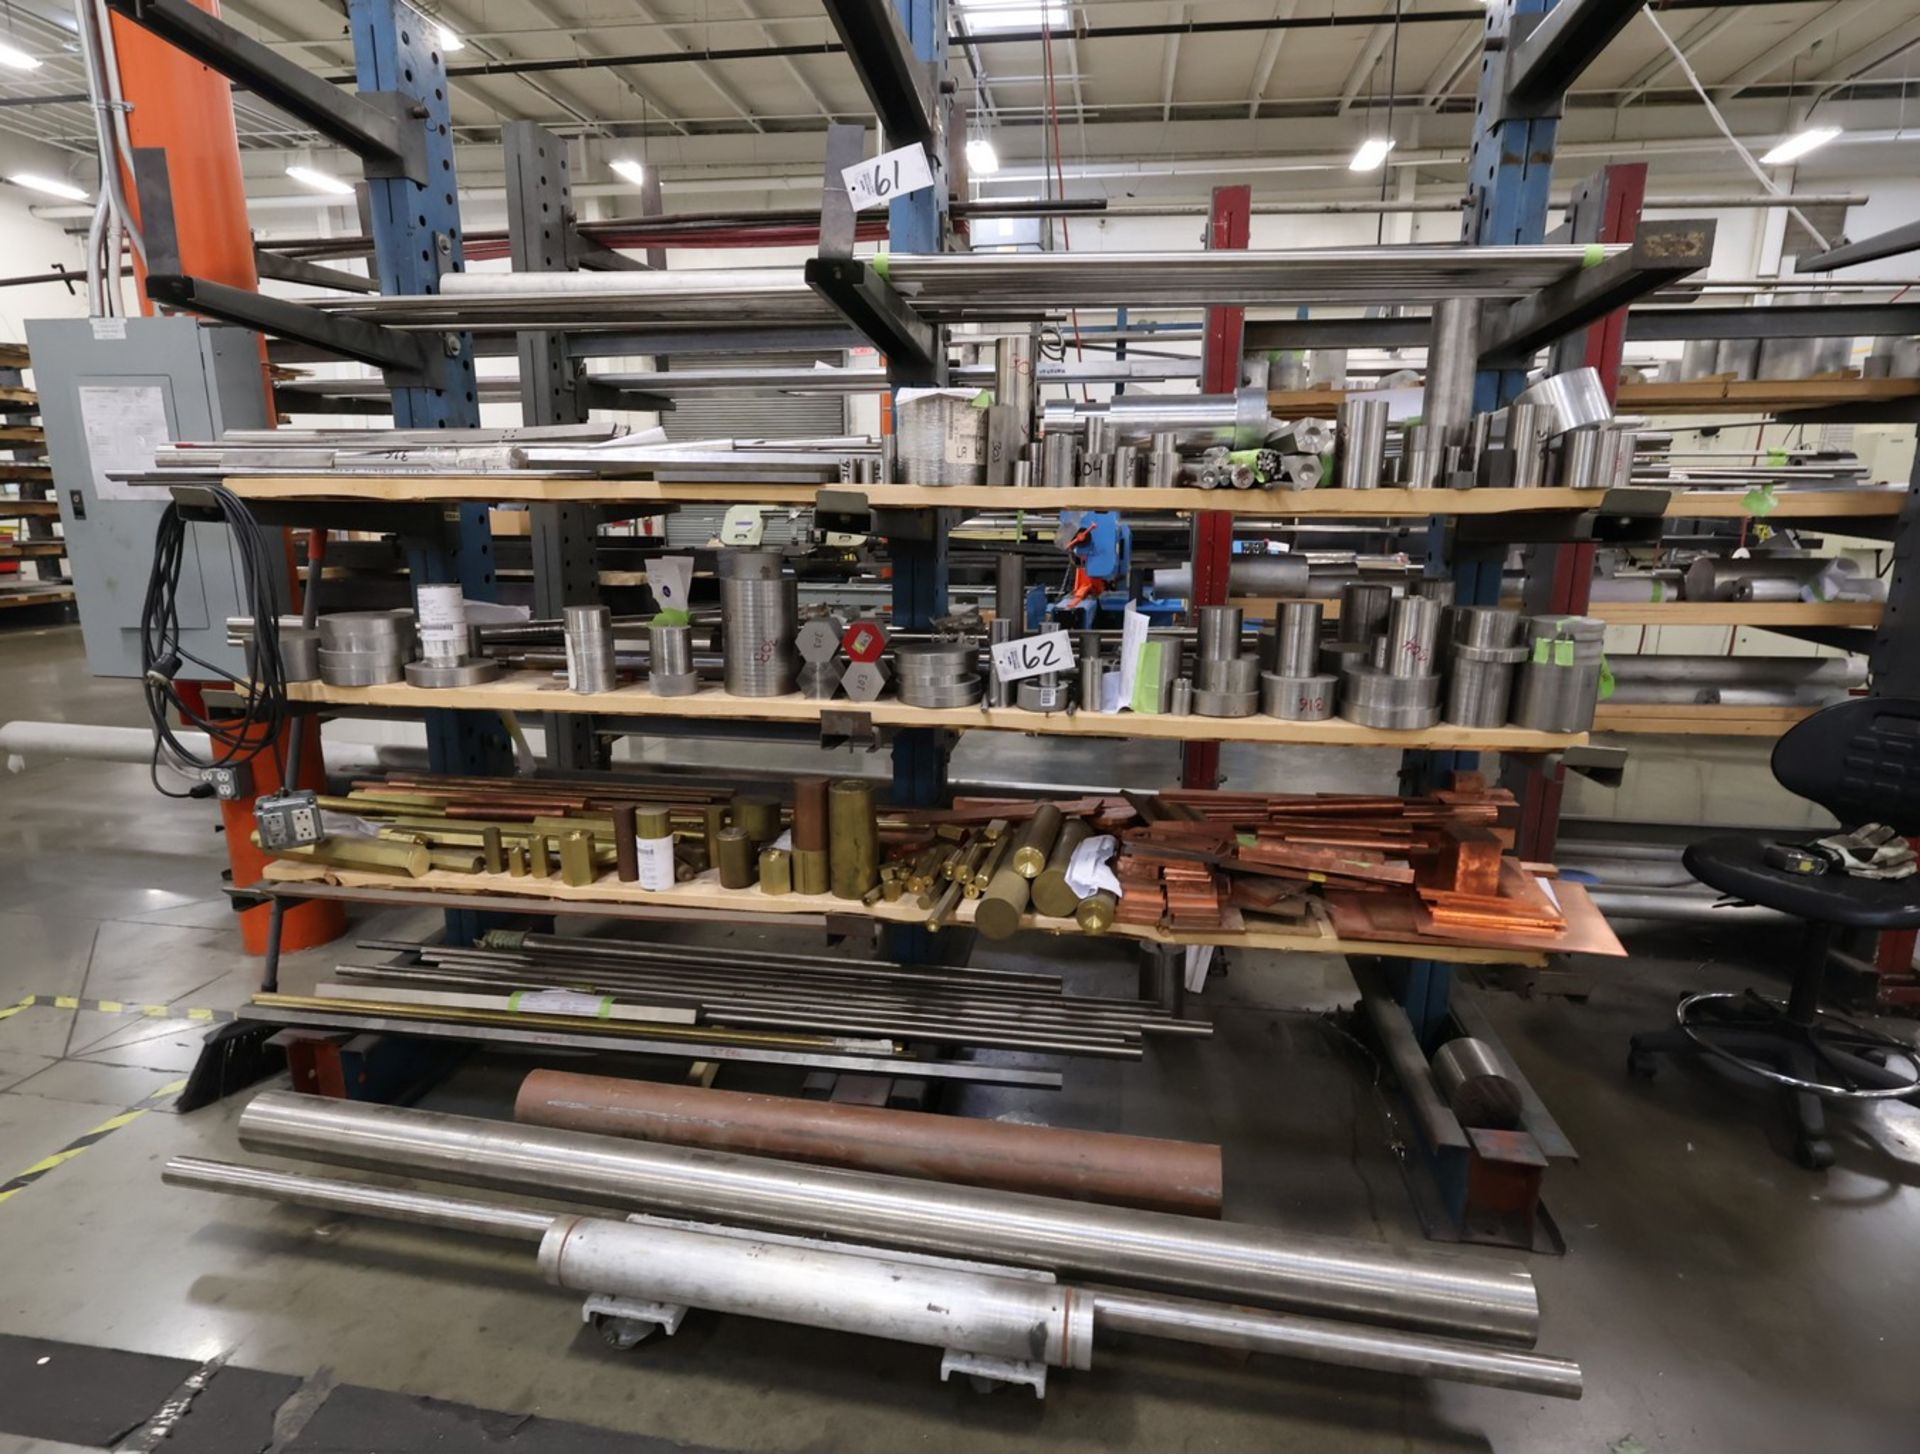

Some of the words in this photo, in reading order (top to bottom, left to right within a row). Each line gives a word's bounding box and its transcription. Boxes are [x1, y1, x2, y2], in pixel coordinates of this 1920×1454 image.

[874, 160, 899, 196] 61
[1022, 641, 1061, 669] 62
[1299, 696, 1325, 712] 316
